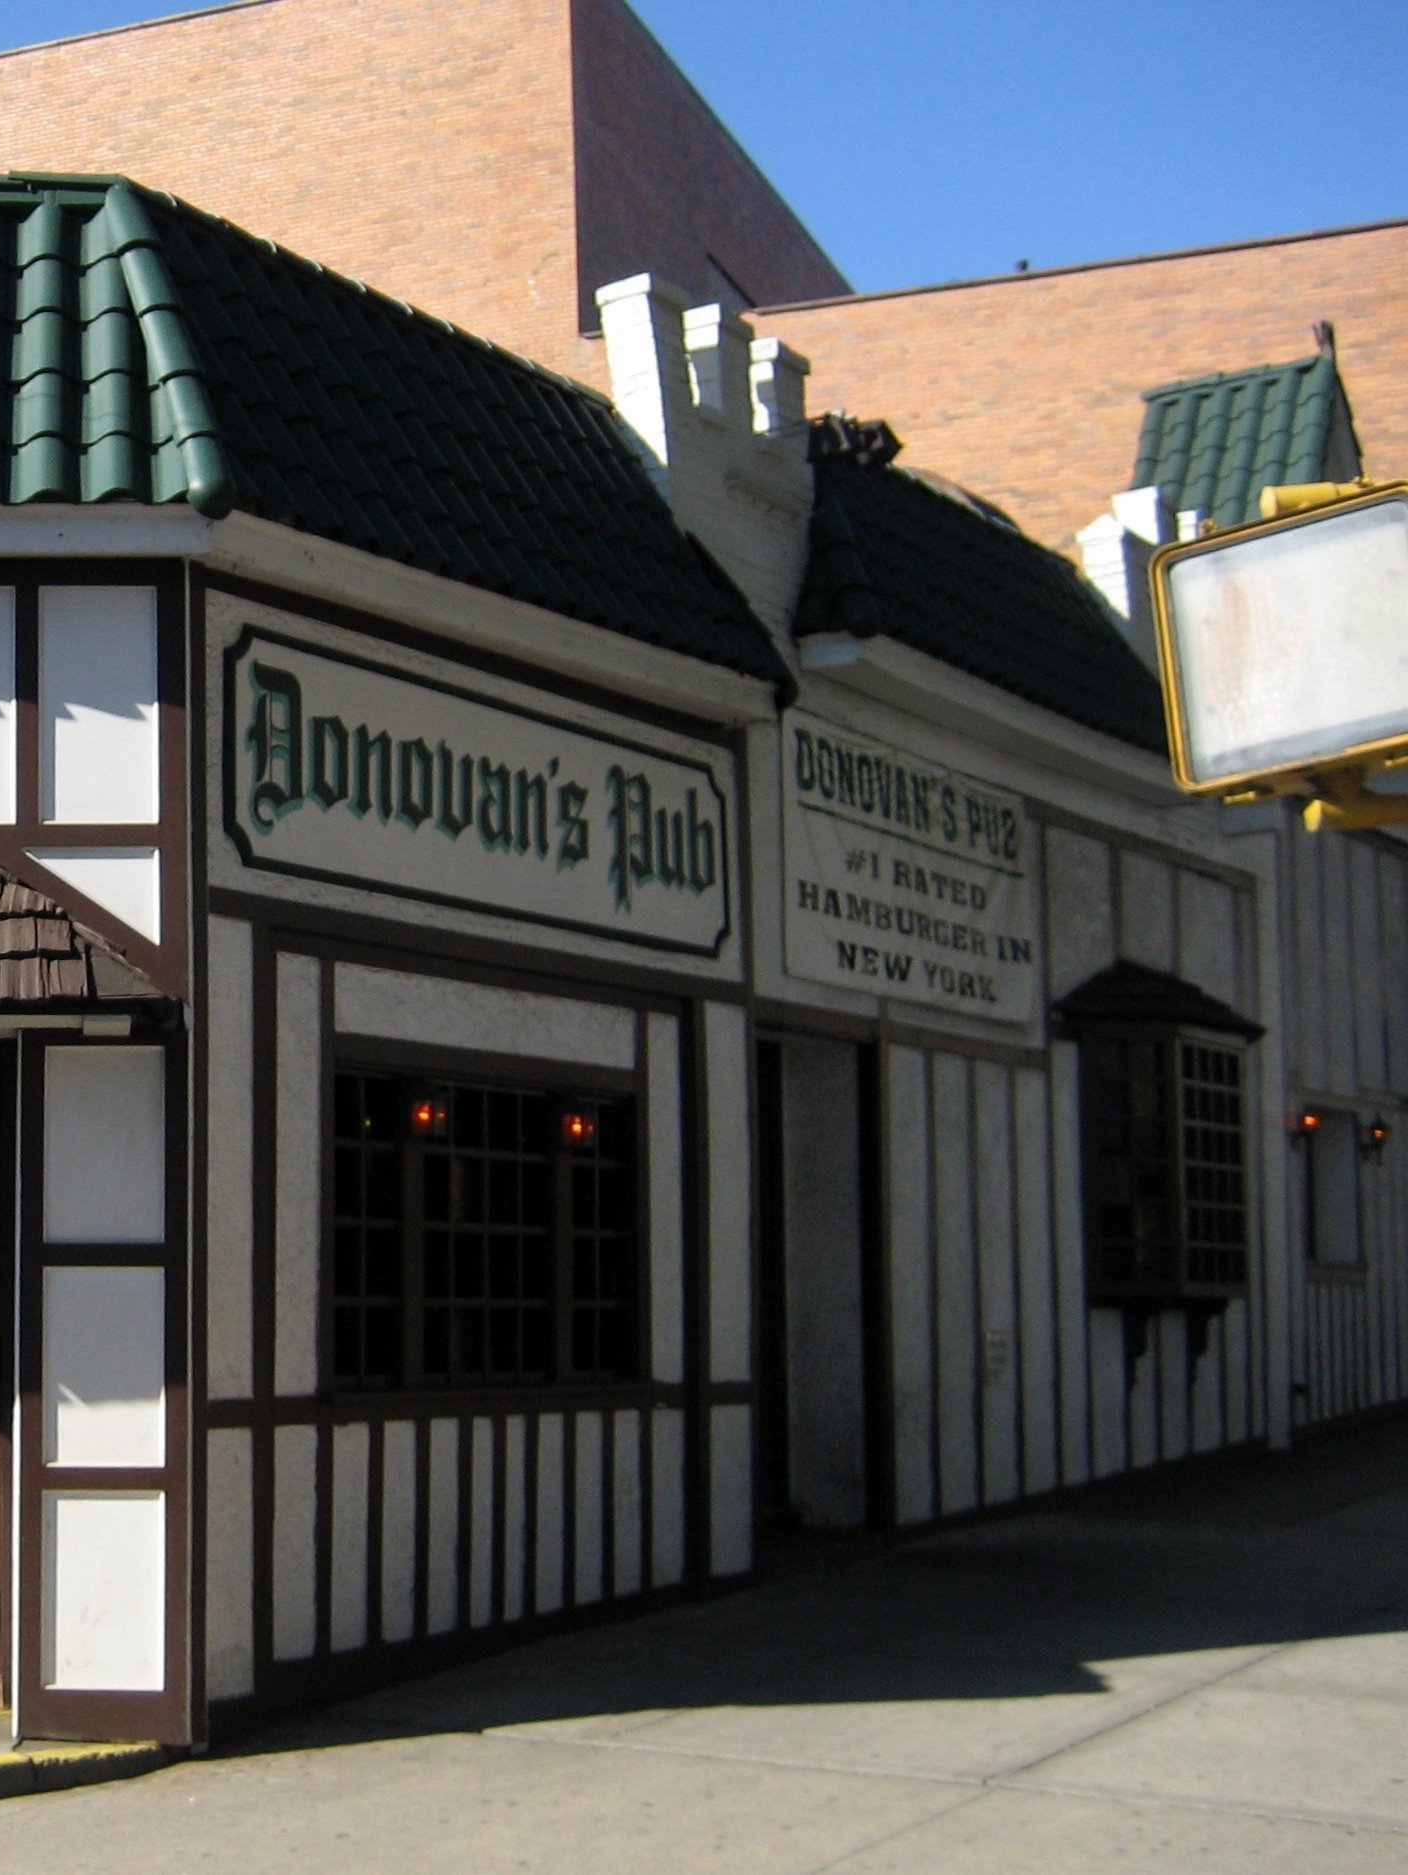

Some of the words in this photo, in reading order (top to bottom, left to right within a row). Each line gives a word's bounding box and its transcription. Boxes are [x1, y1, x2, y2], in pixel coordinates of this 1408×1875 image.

[245, 659, 590, 873] Donovan's
[606, 763, 716, 914] Pub
[794, 726, 958, 843] DONOVAN'S
[797, 878, 988, 957] HAMBURGER
[997, 934, 1032, 964] IN
[844, 848, 880, 880] #1
[893, 859, 987, 911] RATED
[836, 939, 914, 982] NEW
[923, 960, 998, 1002] YORK
